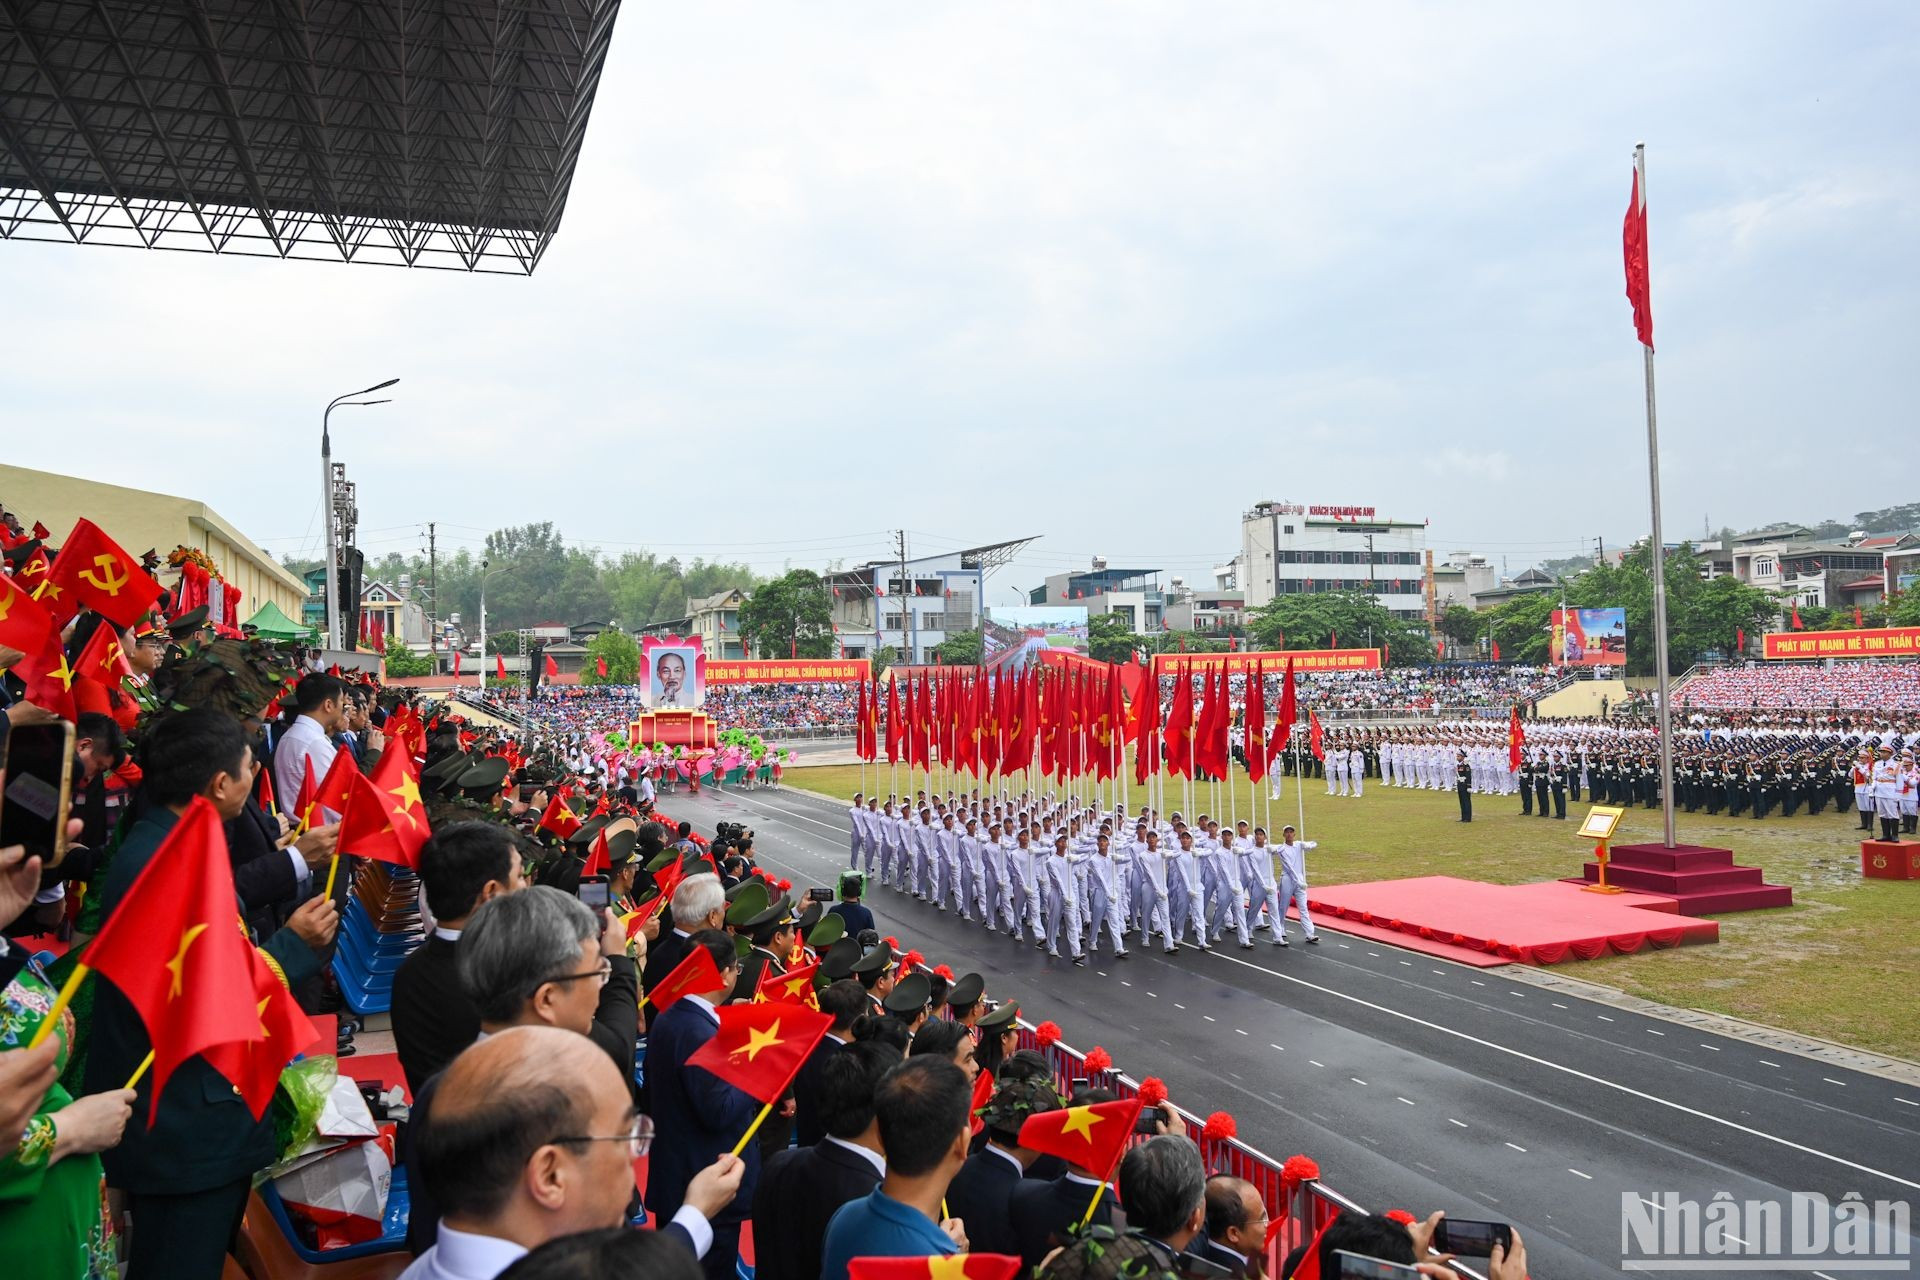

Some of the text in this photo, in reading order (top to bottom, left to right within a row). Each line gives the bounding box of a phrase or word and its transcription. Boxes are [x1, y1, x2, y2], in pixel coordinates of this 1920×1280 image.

[1309, 504, 1329, 516] KHÁCH
[1363, 507, 1375, 516] ANH
[1776, 638, 1798, 652] PHÁT
[1800, 639, 1816, 651] HUY
[1819, 638, 1845, 653] MẠNH
[1864, 637, 1885, 649] TINH
[1888, 632, 1912, 648] THẦN
